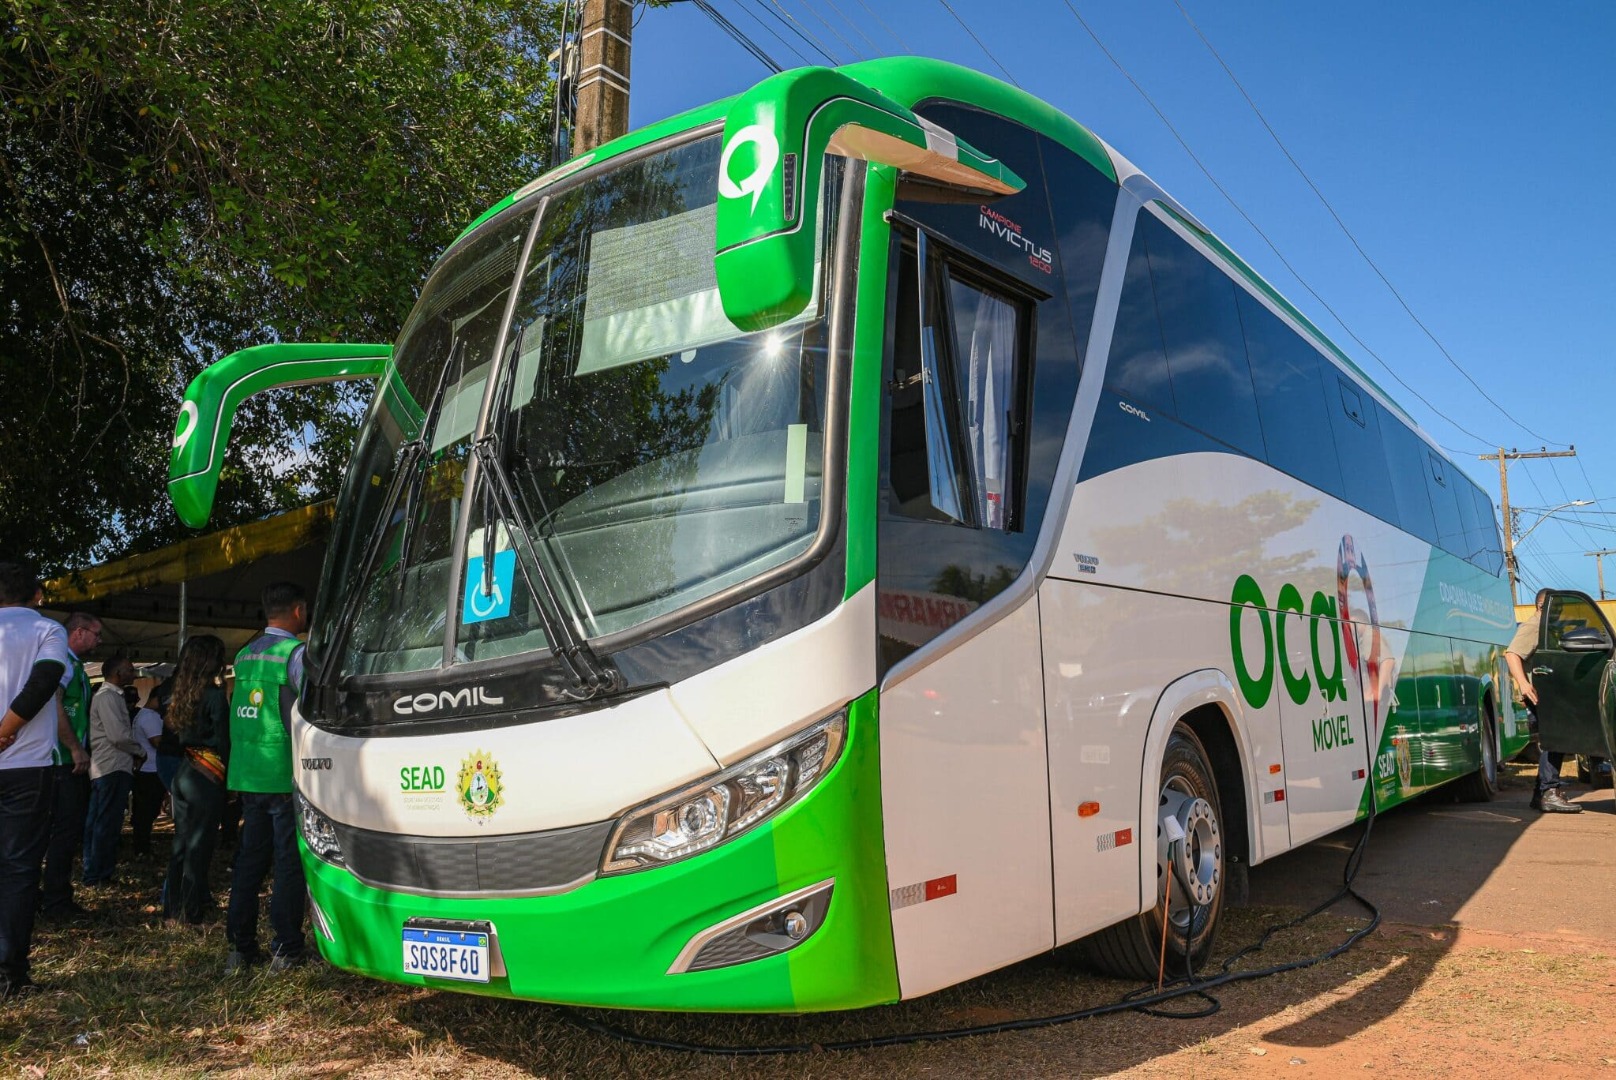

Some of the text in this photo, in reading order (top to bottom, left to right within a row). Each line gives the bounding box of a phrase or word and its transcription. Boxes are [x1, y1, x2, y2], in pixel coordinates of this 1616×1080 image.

[980, 205, 1022, 234] CAMPIONE
[979, 213, 1052, 264] INVICTUS
[1028, 255, 1052, 275] 1200
[1119, 401, 1151, 422] COMIL
[1229, 574, 1347, 709] oca
[393, 686, 504, 714] COMIL
[301, 757, 333, 771] VOLVO
[400, 765, 445, 790] SEAD
[1378, 752, 1395, 779] SEAD
[410, 944, 479, 975] SQS8F60
